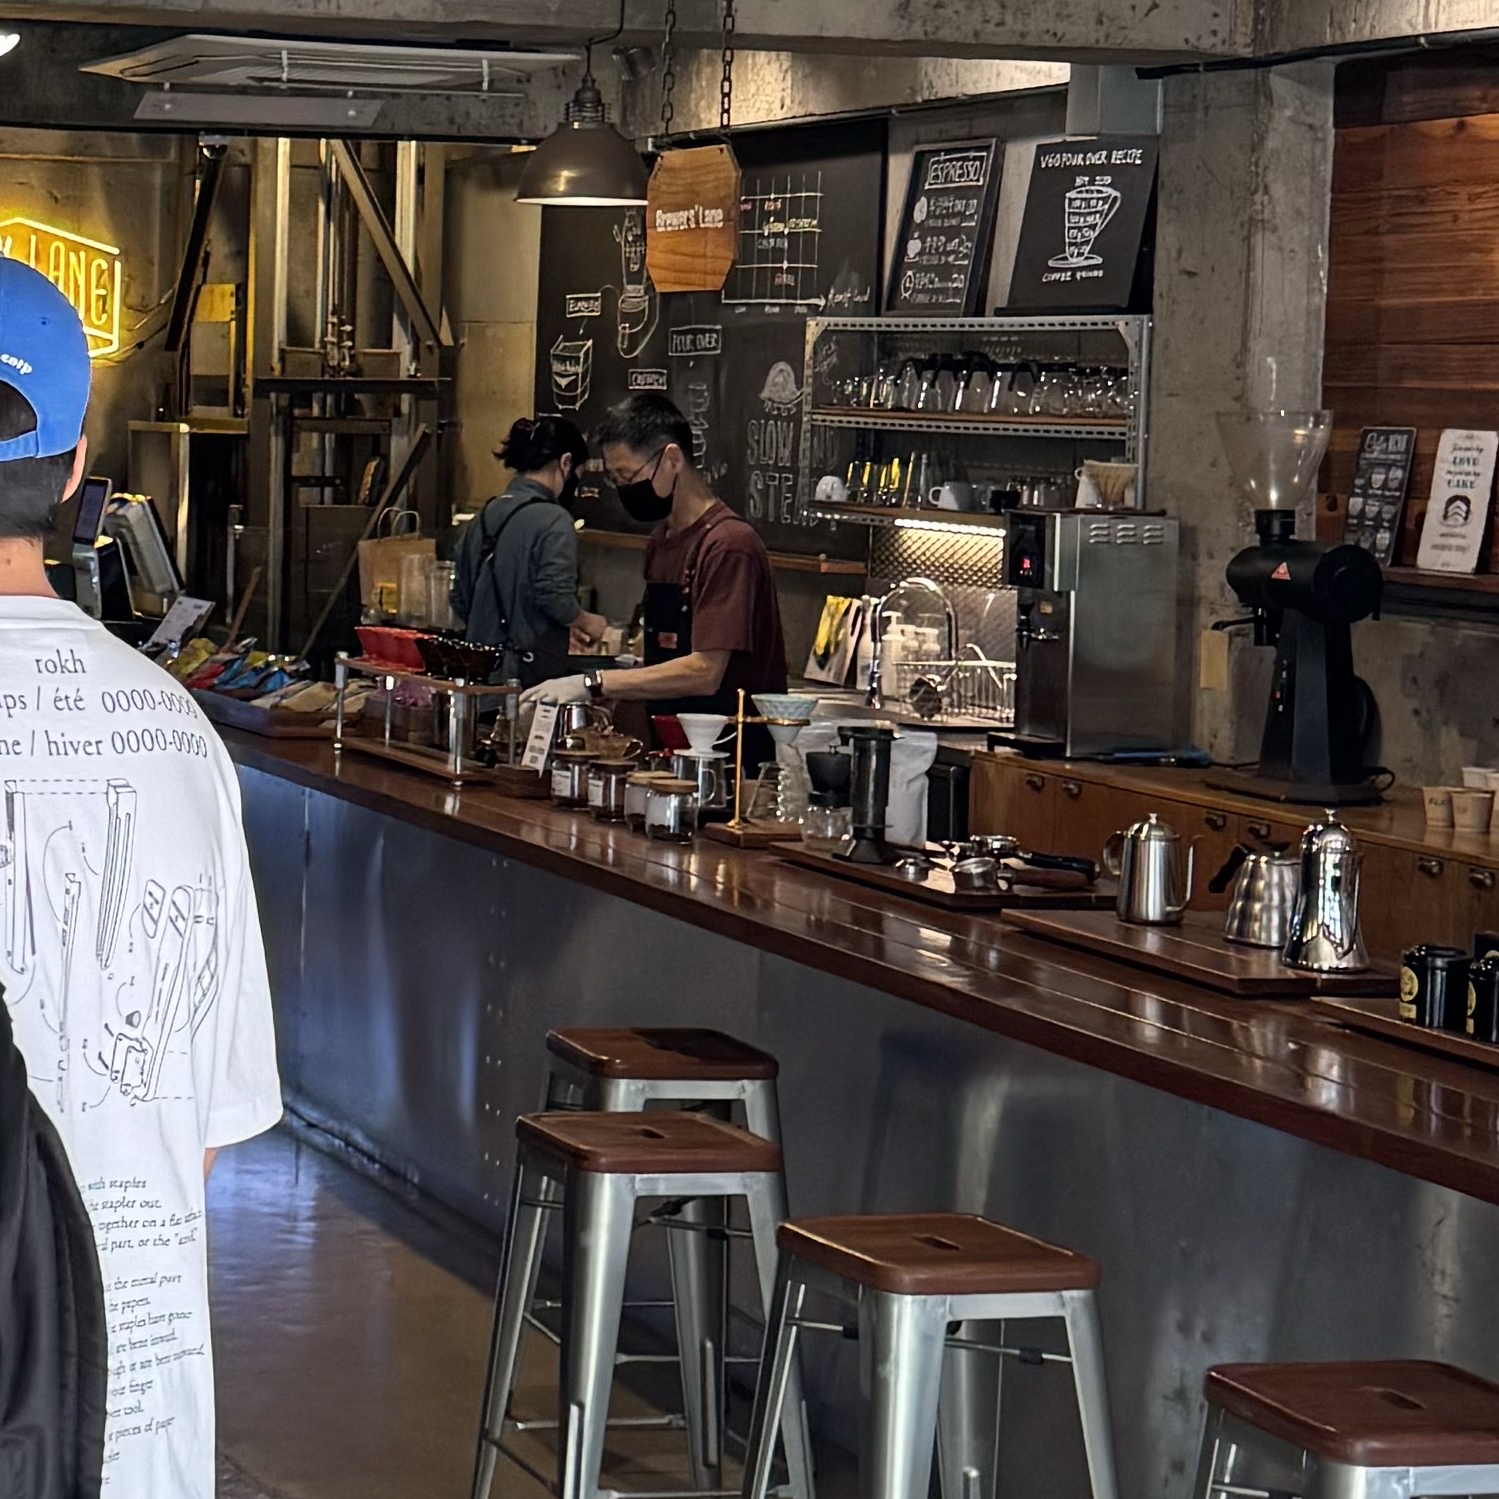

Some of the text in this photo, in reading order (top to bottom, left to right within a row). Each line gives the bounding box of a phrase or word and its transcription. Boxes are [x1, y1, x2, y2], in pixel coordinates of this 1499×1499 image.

[929, 161, 981, 184] ESPRESSO
[698, 205, 724, 228] Lane
[747, 420, 794, 466] SLOW
[35, 649, 87, 675] rokh
[36, 686, 42, 712] /
[53, 687, 87, 712] été
[30, 730, 36, 757] /
[45, 730, 104, 757] hiver
[111, 728, 208, 759] 0000-0000
[98, 1215, 140, 1234] ogether
